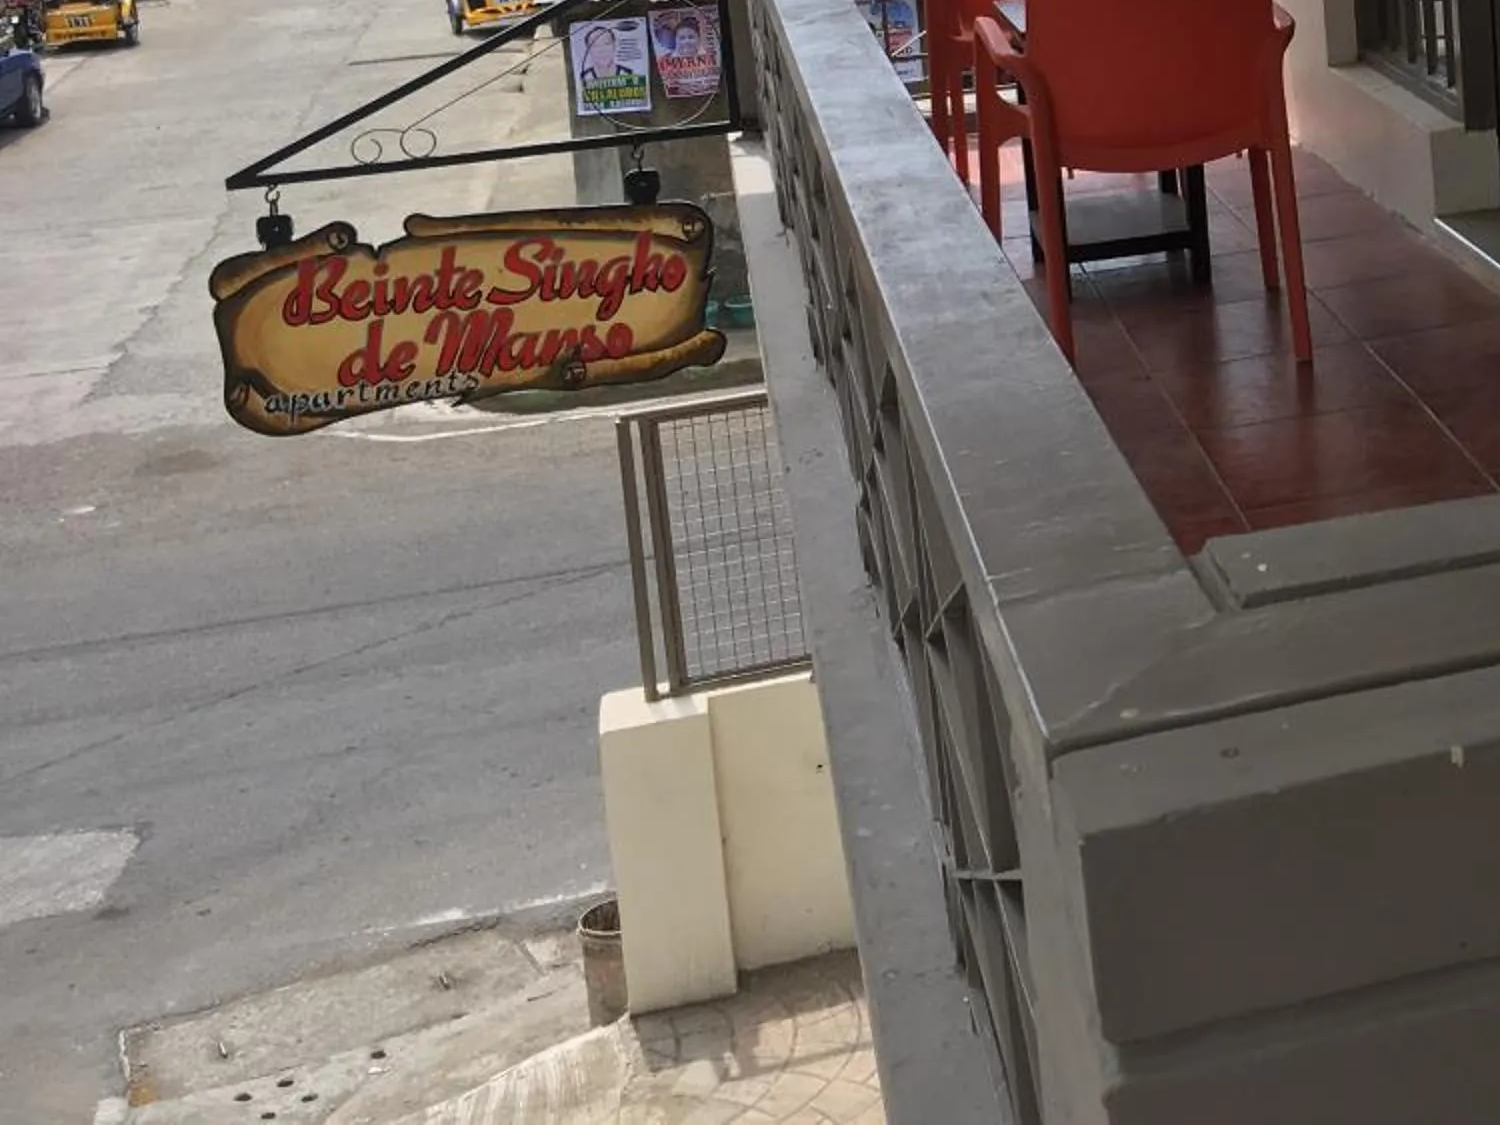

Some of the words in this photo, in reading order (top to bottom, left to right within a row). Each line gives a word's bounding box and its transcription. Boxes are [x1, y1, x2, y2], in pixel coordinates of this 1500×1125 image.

[282, 246, 485, 326] Beinte
[337, 319, 419, 387] de
[264, 371, 481, 420] apartments
